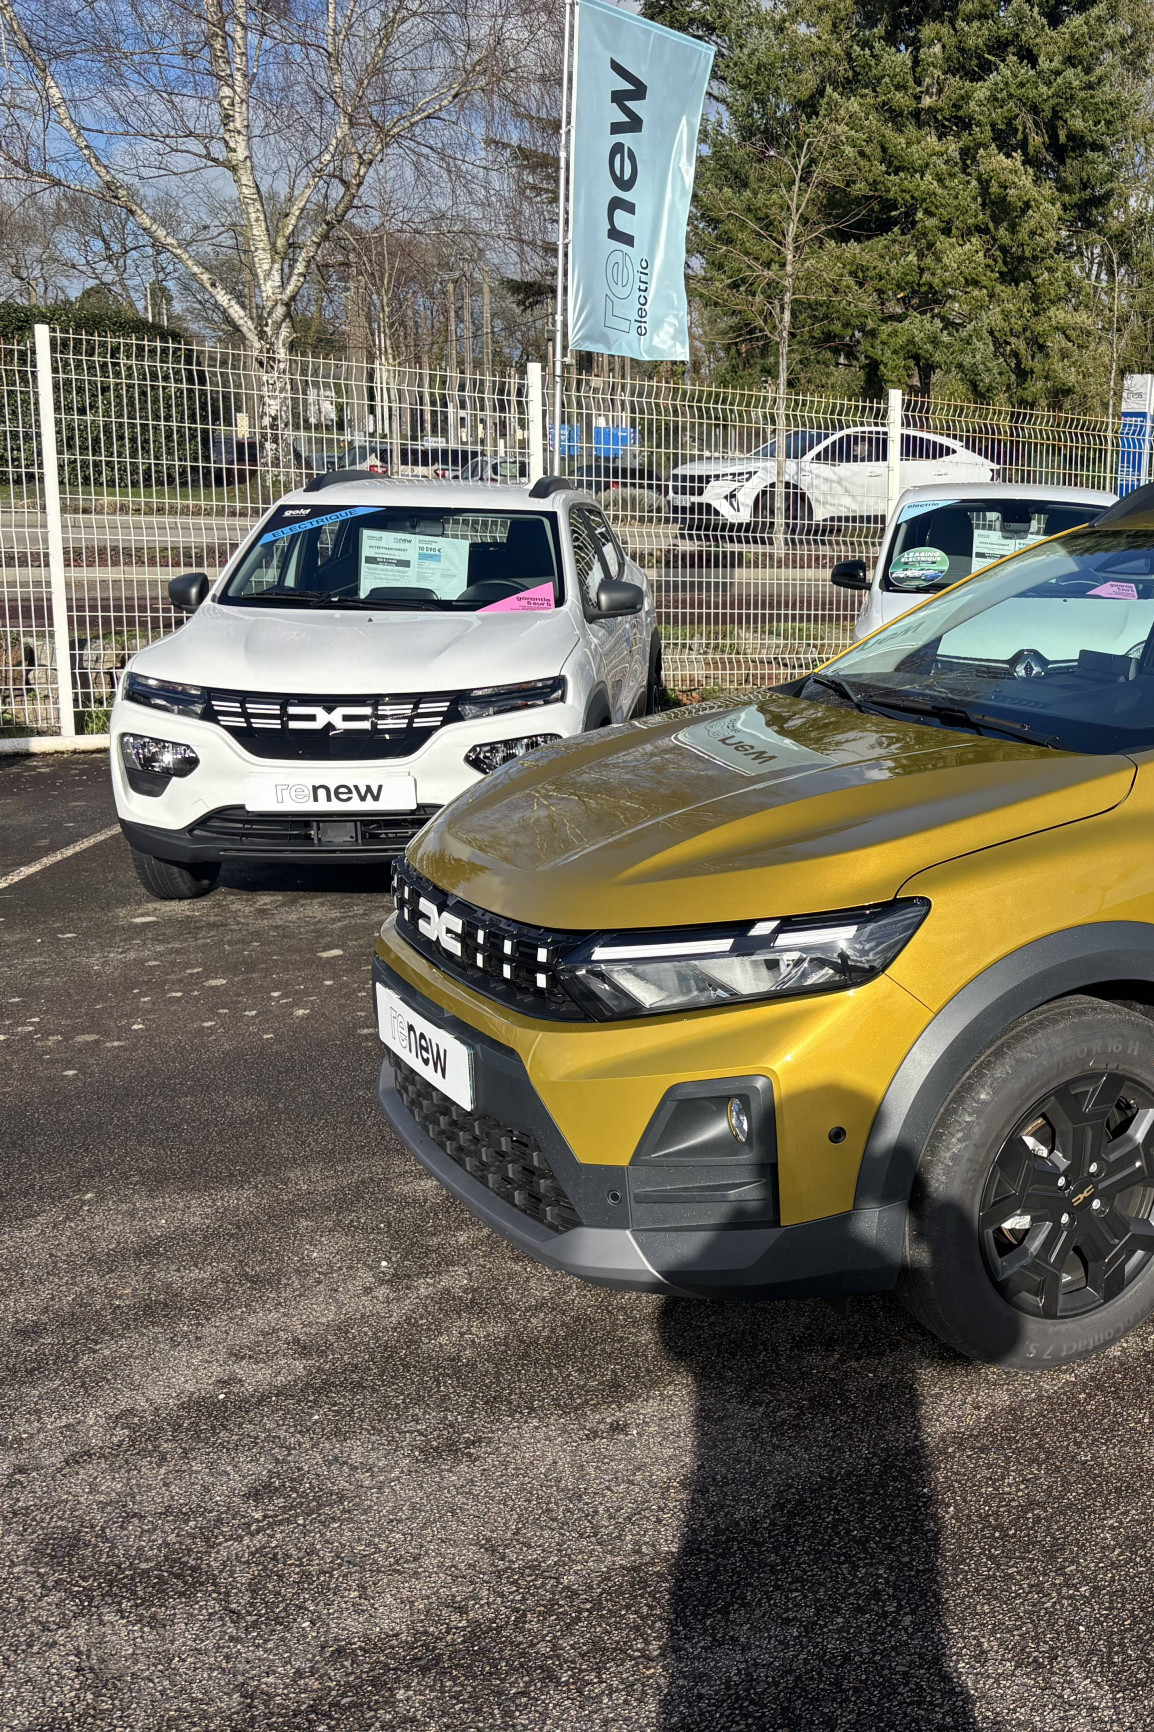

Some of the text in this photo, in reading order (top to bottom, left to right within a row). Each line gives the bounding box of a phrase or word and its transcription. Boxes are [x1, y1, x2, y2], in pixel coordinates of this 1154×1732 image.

[603, 57, 648, 334] renew
[636, 257, 649, 337] electric
[271, 509, 359, 539] ELECTRIQUE
[283, 508, 312, 516] gold
[274, 783, 384, 804] renew
[389, 1005, 448, 1080] renew
